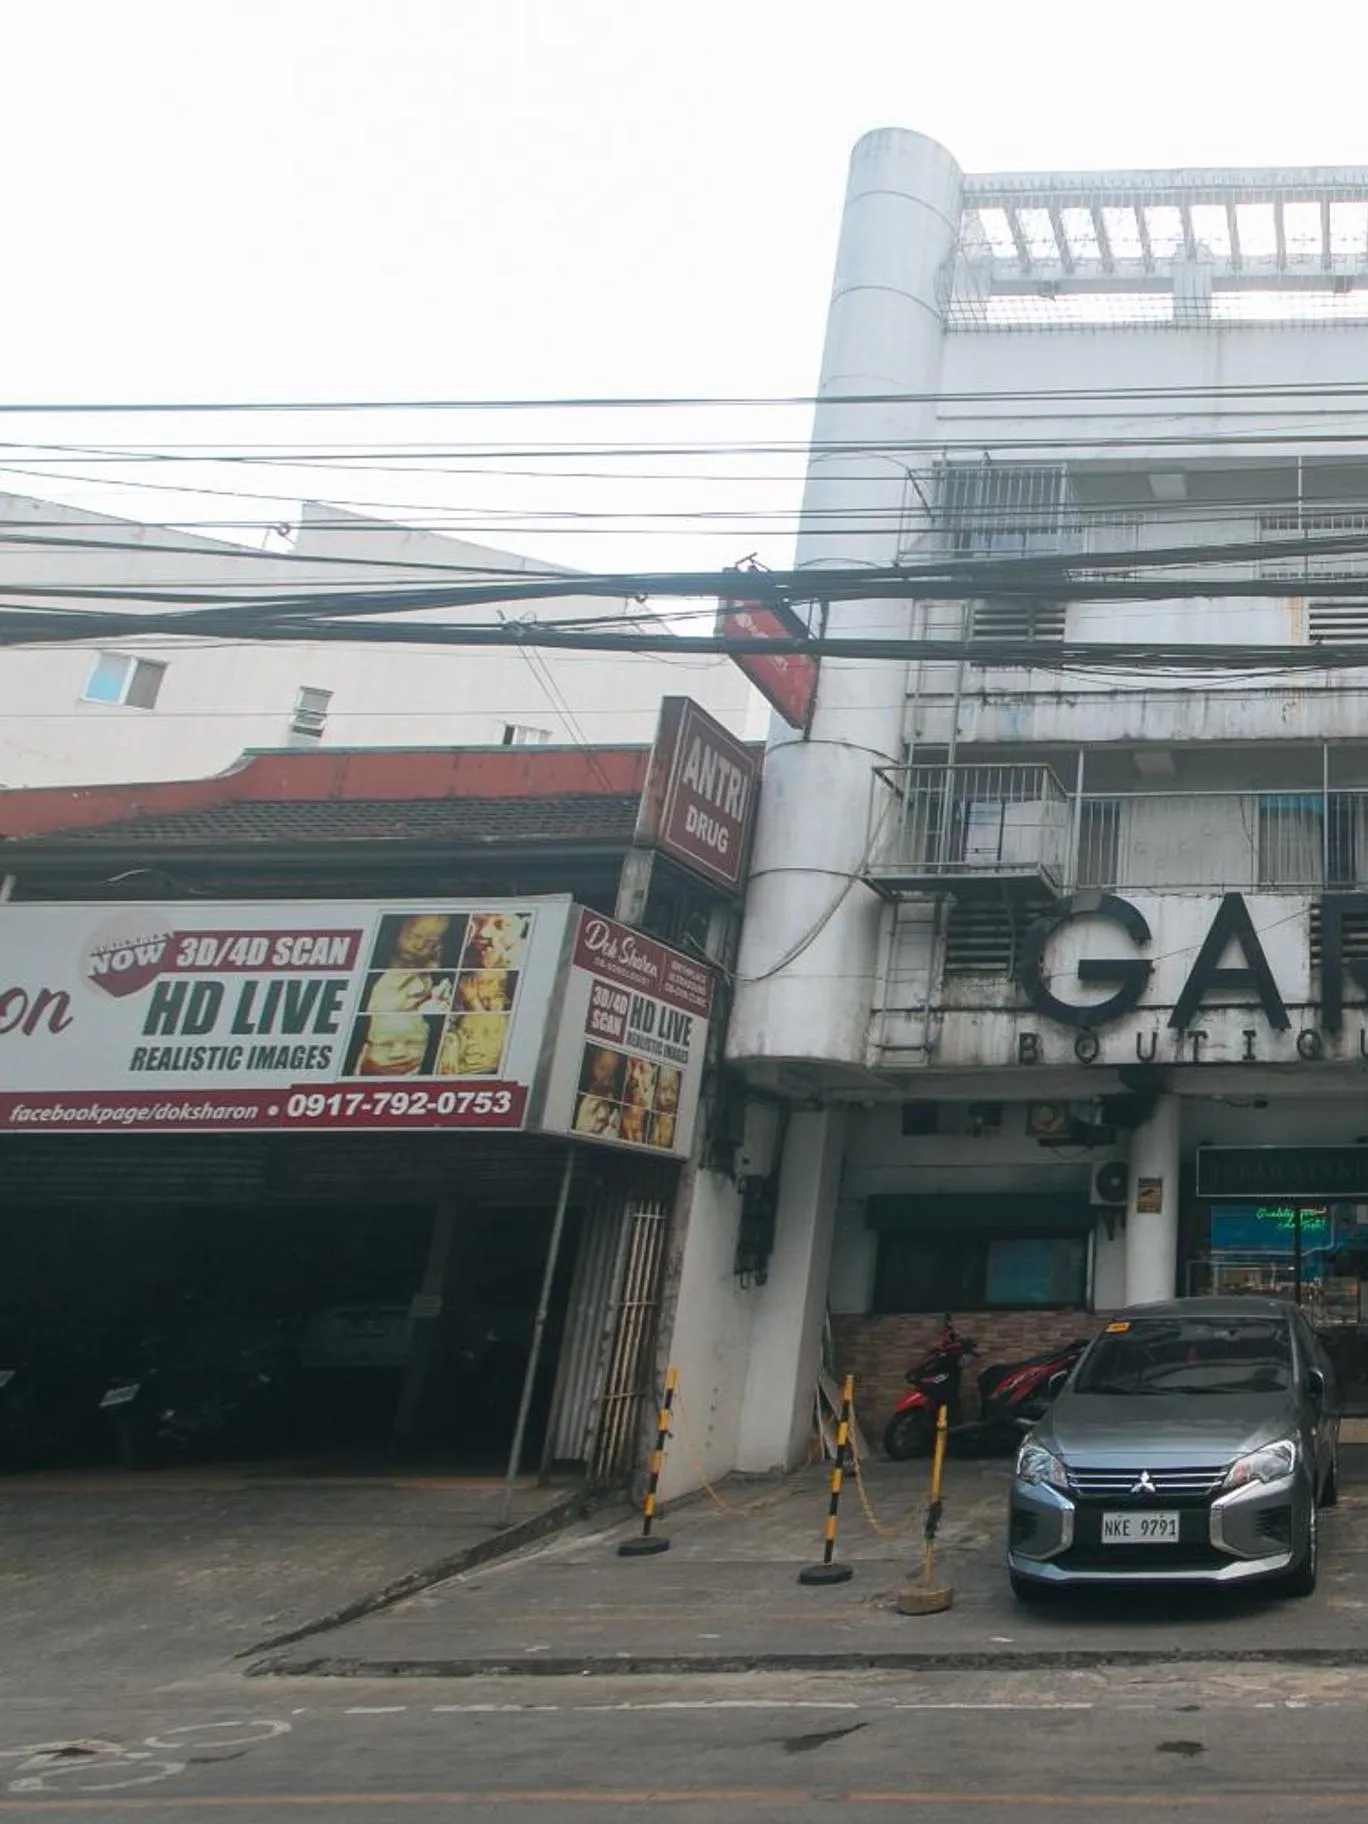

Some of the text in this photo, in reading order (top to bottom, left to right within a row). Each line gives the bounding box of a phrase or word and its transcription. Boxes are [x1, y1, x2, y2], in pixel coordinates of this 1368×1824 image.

[685, 804, 729, 854] DRUG
[87, 942, 167, 976] NOW
[176, 936, 271, 968] 3D/4D
[272, 936, 351, 967] SCAN
[142, 979, 350, 1036] HD LIVE
[630, 995, 694, 1047] HD LIVE
[129, 1044, 333, 1072] REALISTIC IMAGES
[8, 1090, 512, 1127] facebookpage/doksharon 0917-792-0753
[1104, 1518, 1177, 1537] NKE 9791
